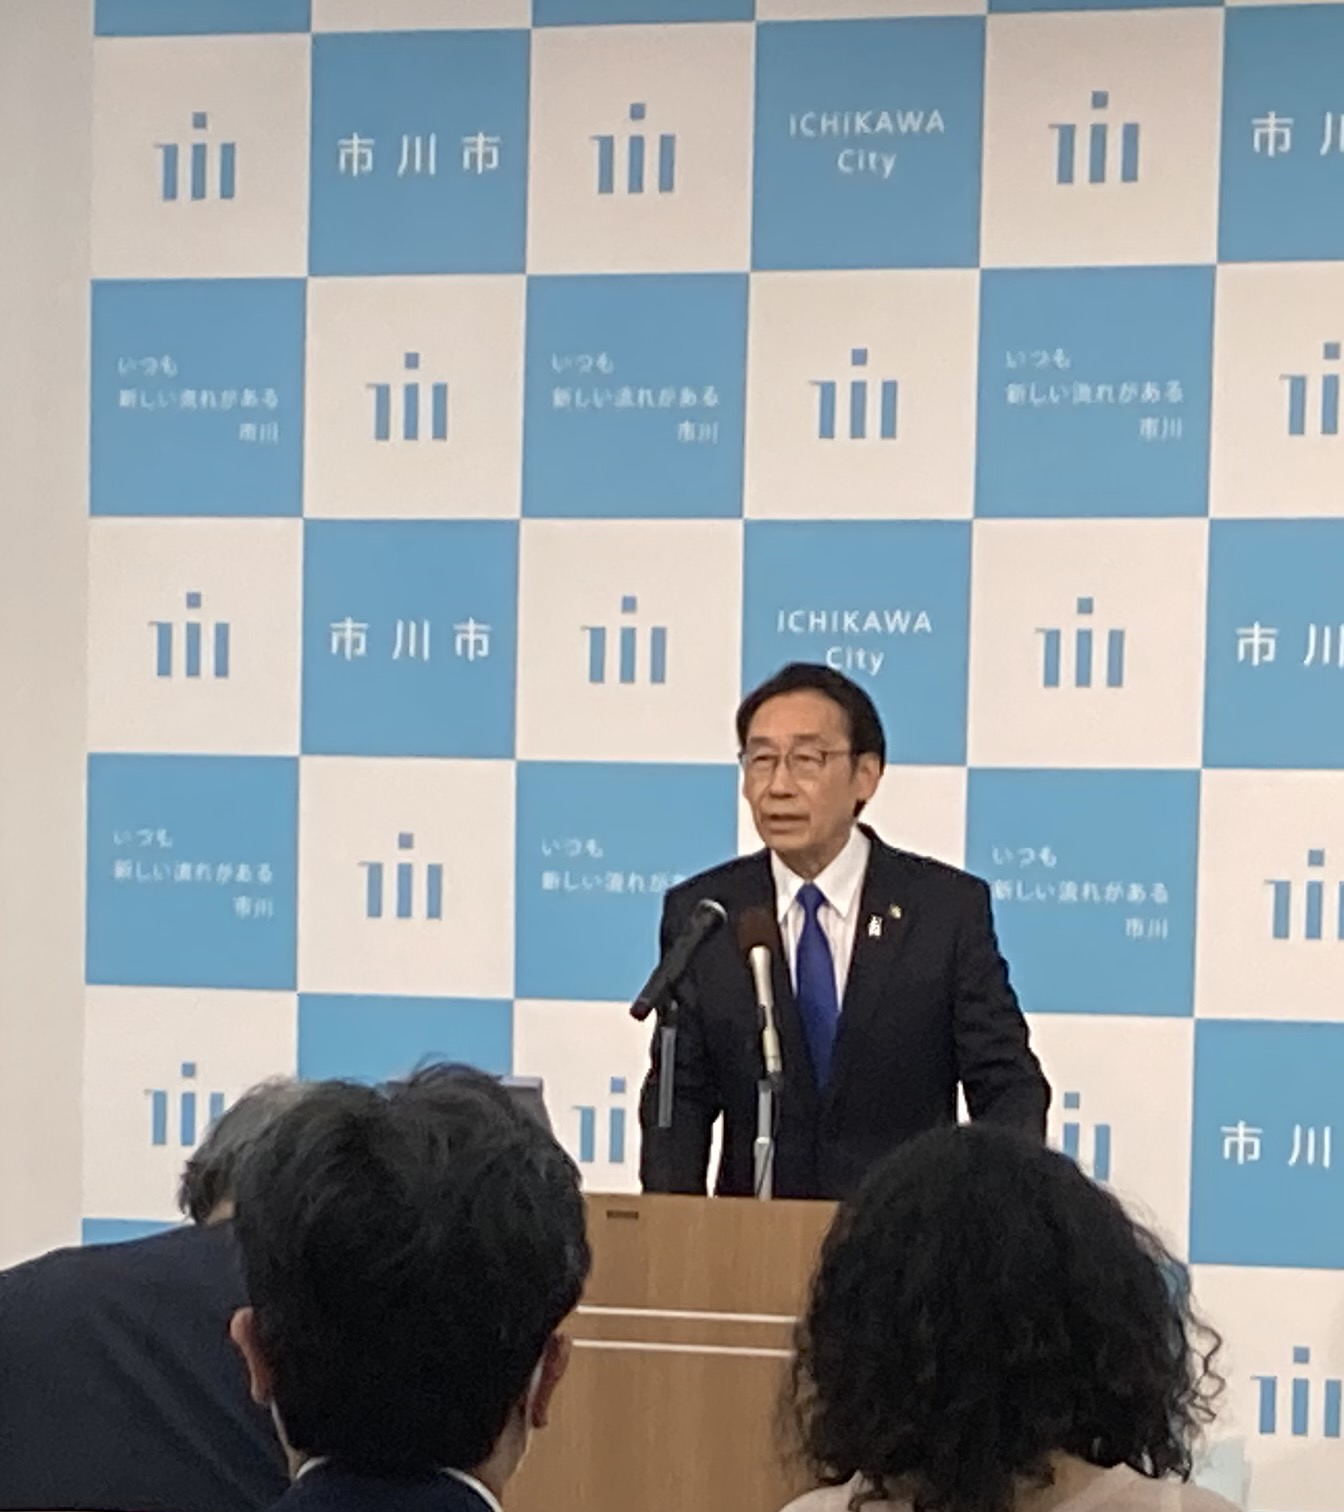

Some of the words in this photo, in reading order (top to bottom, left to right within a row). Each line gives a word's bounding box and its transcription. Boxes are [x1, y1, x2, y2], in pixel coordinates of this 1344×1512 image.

[790, 110, 944, 136] ICHIKAWA
[339, 132, 499, 176] 市川市
[838, 149, 896, 178] City
[119, 355, 177, 376] いつも
[552, 352, 613, 373] いつも
[1006, 348, 1071, 368] いつも
[119, 388, 278, 409] 新しい流れがある
[553, 386, 718, 408] 新しい流れがある
[1006, 381, 1182, 406] 新しい流れがある
[240, 422, 278, 442] 市川
[678, 420, 717, 442] 市川
[1140, 417, 1182, 440] 市川
[777, 609, 932, 636] ICHIKAWA
[330, 617, 490, 661] 市川市
[825, 645, 884, 676] City
[114, 829, 172, 849] いつも
[542, 839, 603, 858] いつも
[993, 847, 1056, 867] いつも
[113, 860, 272, 883] 新しい流れがある
[991, 879, 1168, 904] 新しい流れがある
[234, 896, 272, 917] 市川
[1126, 918, 1168, 938] 市川
